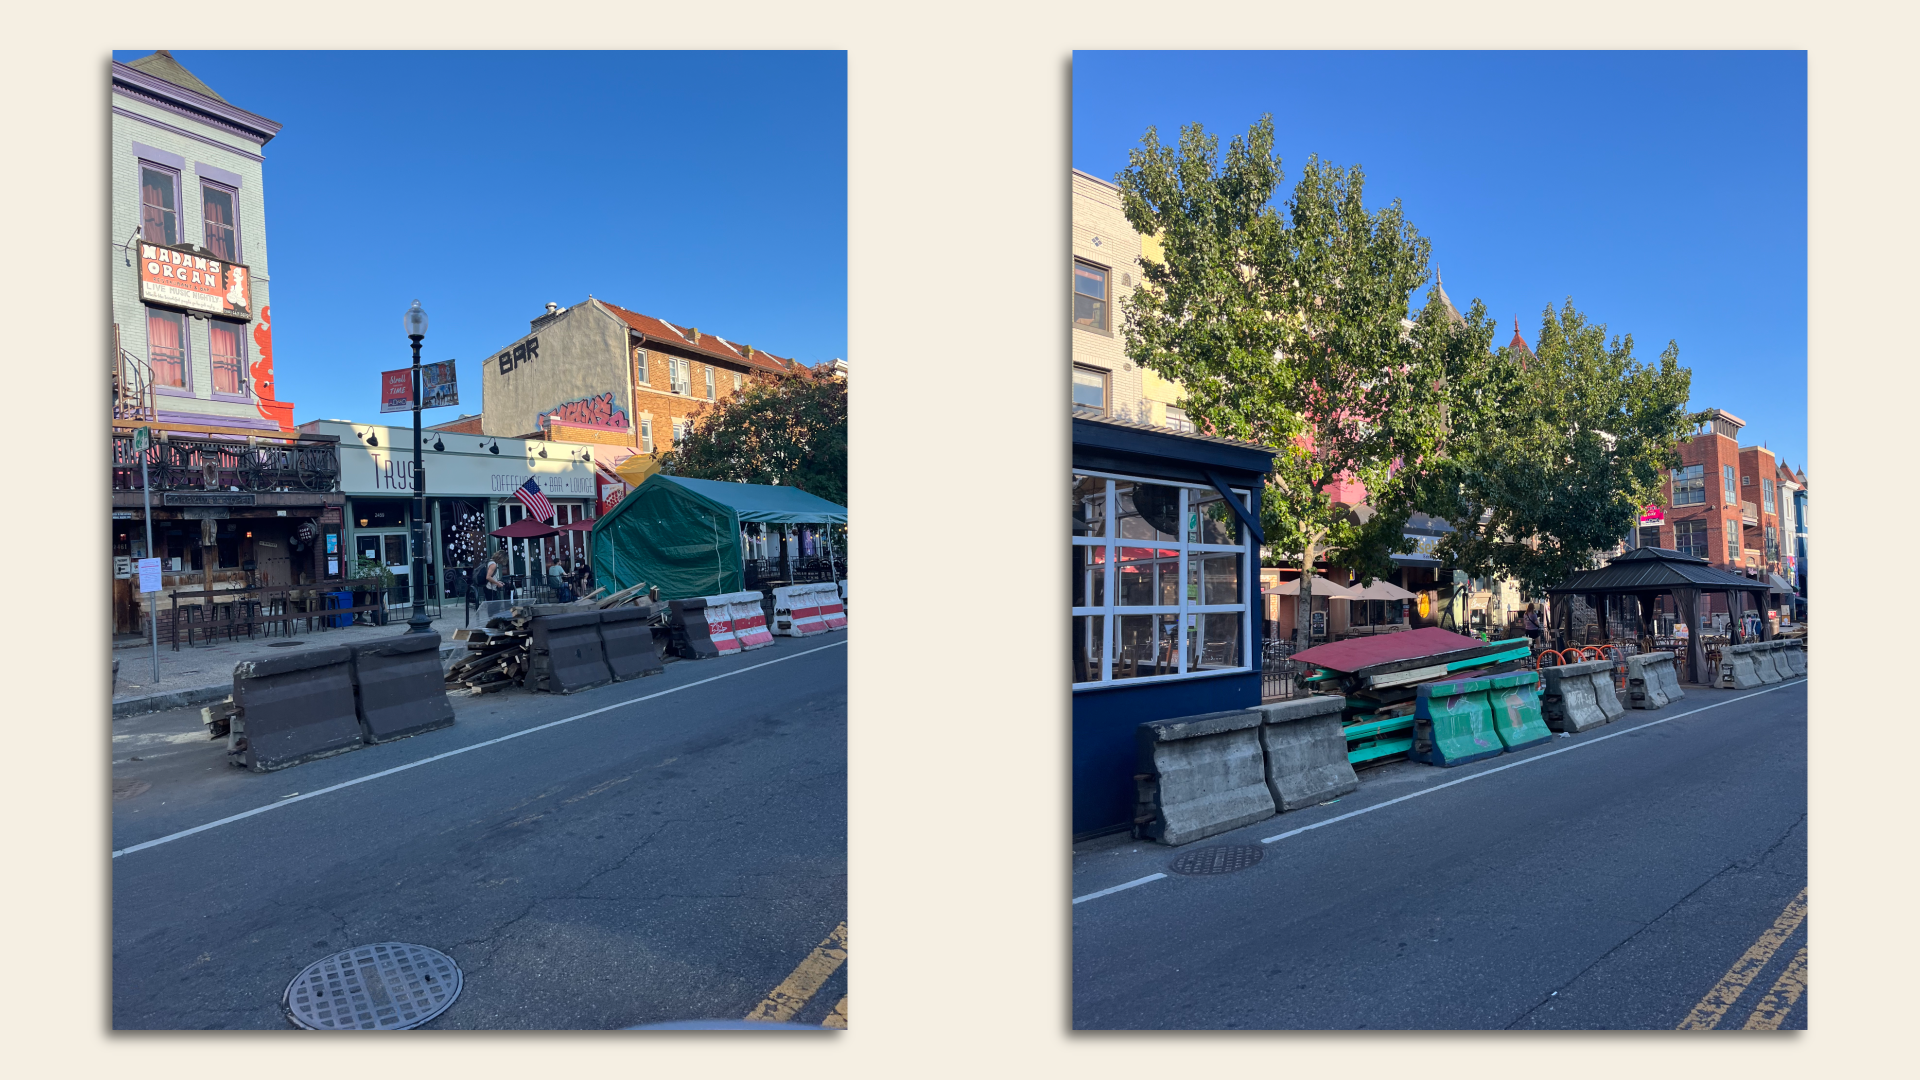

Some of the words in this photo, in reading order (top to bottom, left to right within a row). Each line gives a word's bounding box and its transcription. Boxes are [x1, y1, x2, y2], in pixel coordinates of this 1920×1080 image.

[142, 245, 220, 273] MADAM'S
[147, 261, 216, 288] ORGAN
[153, 277, 192, 289] RESTAURANT
[146, 282, 166, 293] LIVE
[169, 286, 192, 299] MUSIC
[192, 290, 219, 304] NIGHTLY
[498, 336, 539, 376] BAR
[389, 386, 406, 395] TIME
[371, 453, 425, 490] TRYS
[491, 474, 541, 492] COFFEEHE
[549, 476, 563, 493] BAR
[569, 477, 594, 494] LOUNGE
